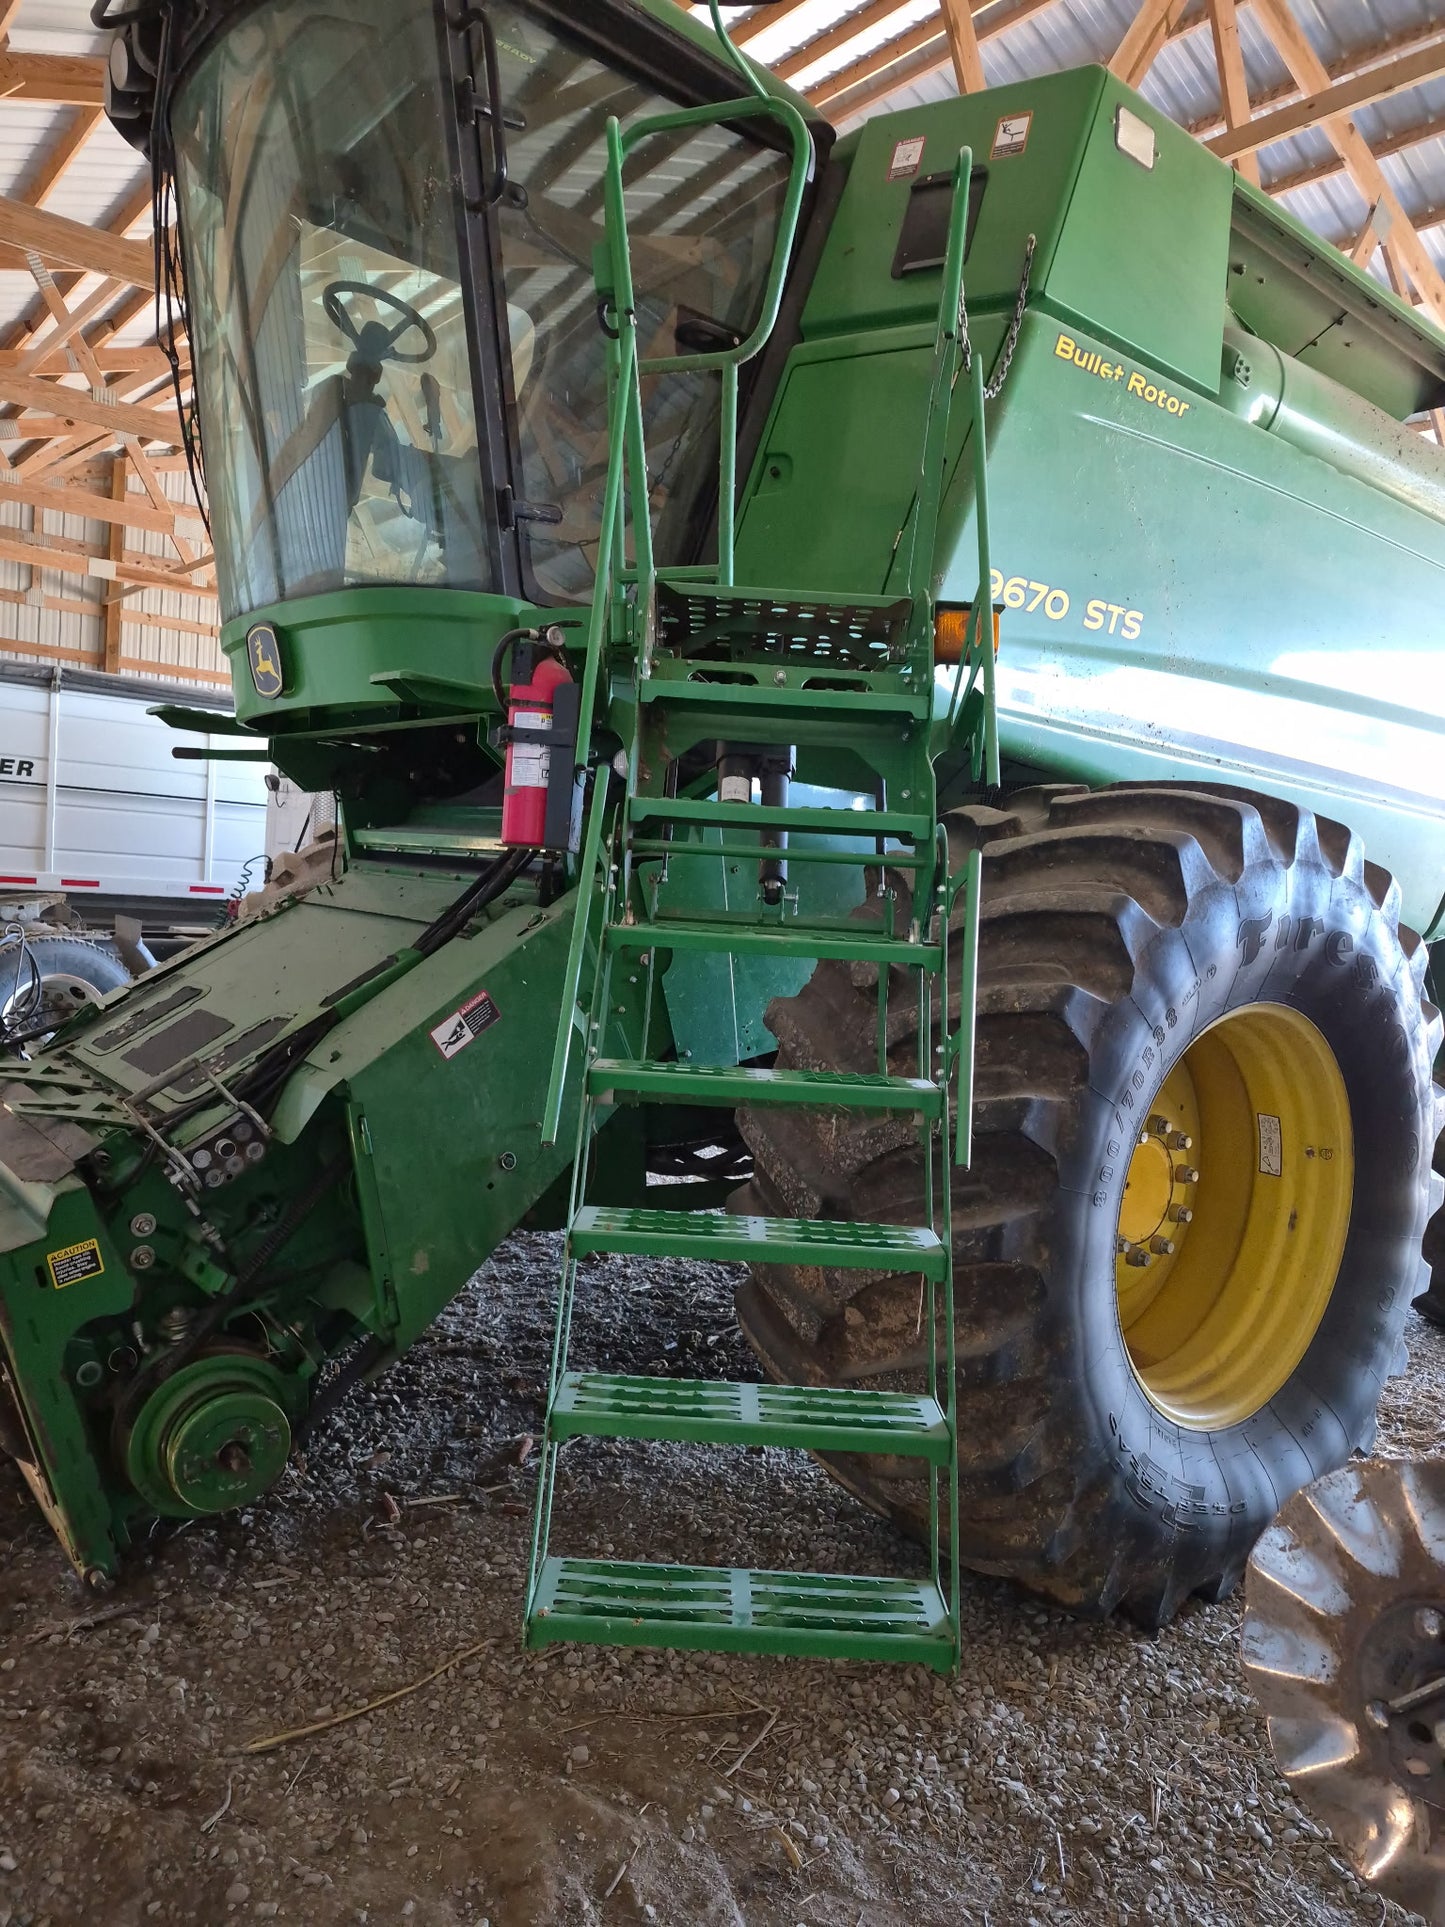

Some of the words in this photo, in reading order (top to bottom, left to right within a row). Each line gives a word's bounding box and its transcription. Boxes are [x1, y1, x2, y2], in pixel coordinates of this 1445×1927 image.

[1054, 333, 1125, 382] Bullet
[1126, 371, 1191, 418] Rotor
[990, 567, 1070, 621] 9670
[1083, 598, 1145, 641] STS
[0, 757, 34, 777] ER
[57, 1240, 96, 1259] CAUTION
